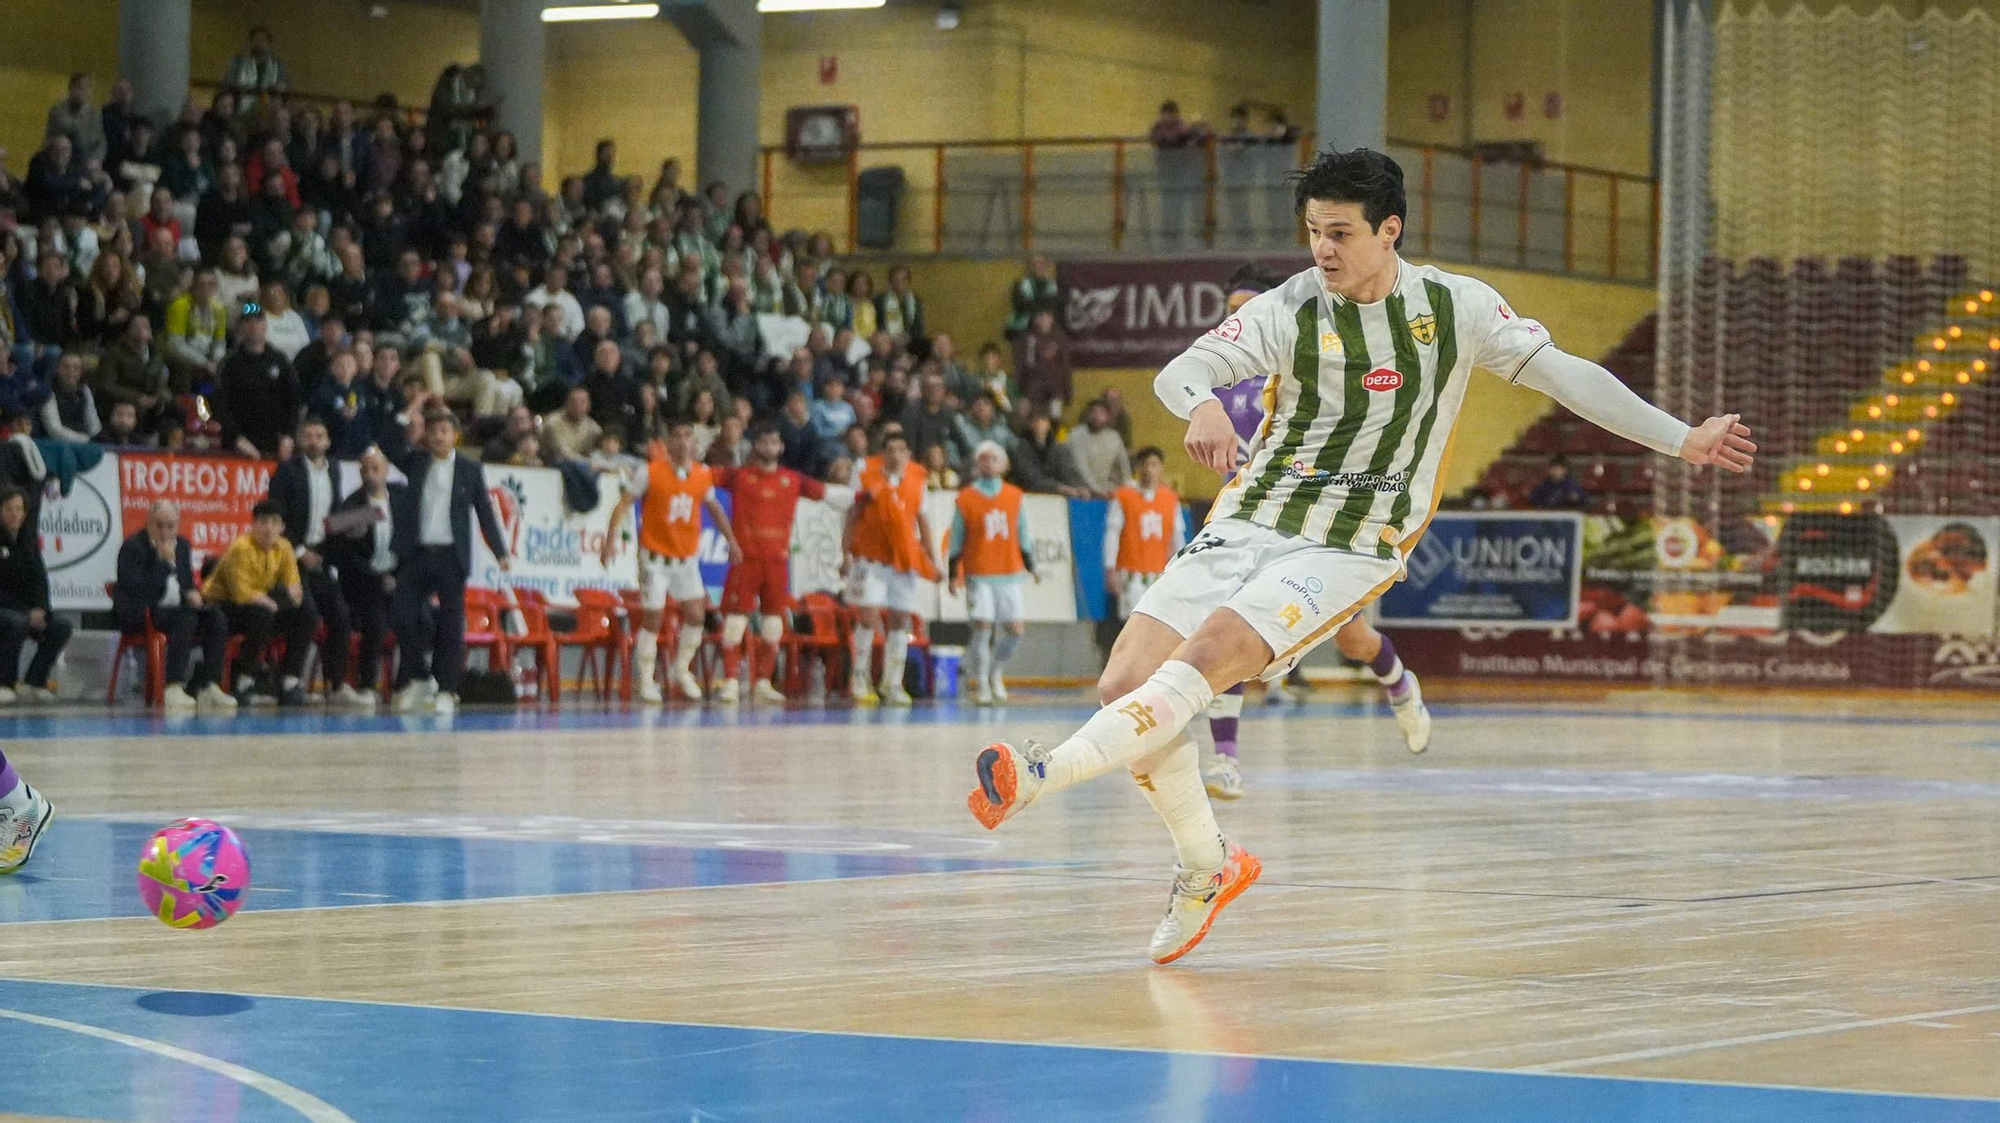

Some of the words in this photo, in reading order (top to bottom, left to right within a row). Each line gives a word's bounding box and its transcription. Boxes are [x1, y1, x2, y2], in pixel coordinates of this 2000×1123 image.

[123, 459, 229, 496] TROFEOS
[41, 510, 104, 534] oldadura
[1280, 577, 1321, 617] LeoProex
[1460, 653, 1539, 673] Instituto
[1542, 654, 1639, 678] Municipal
